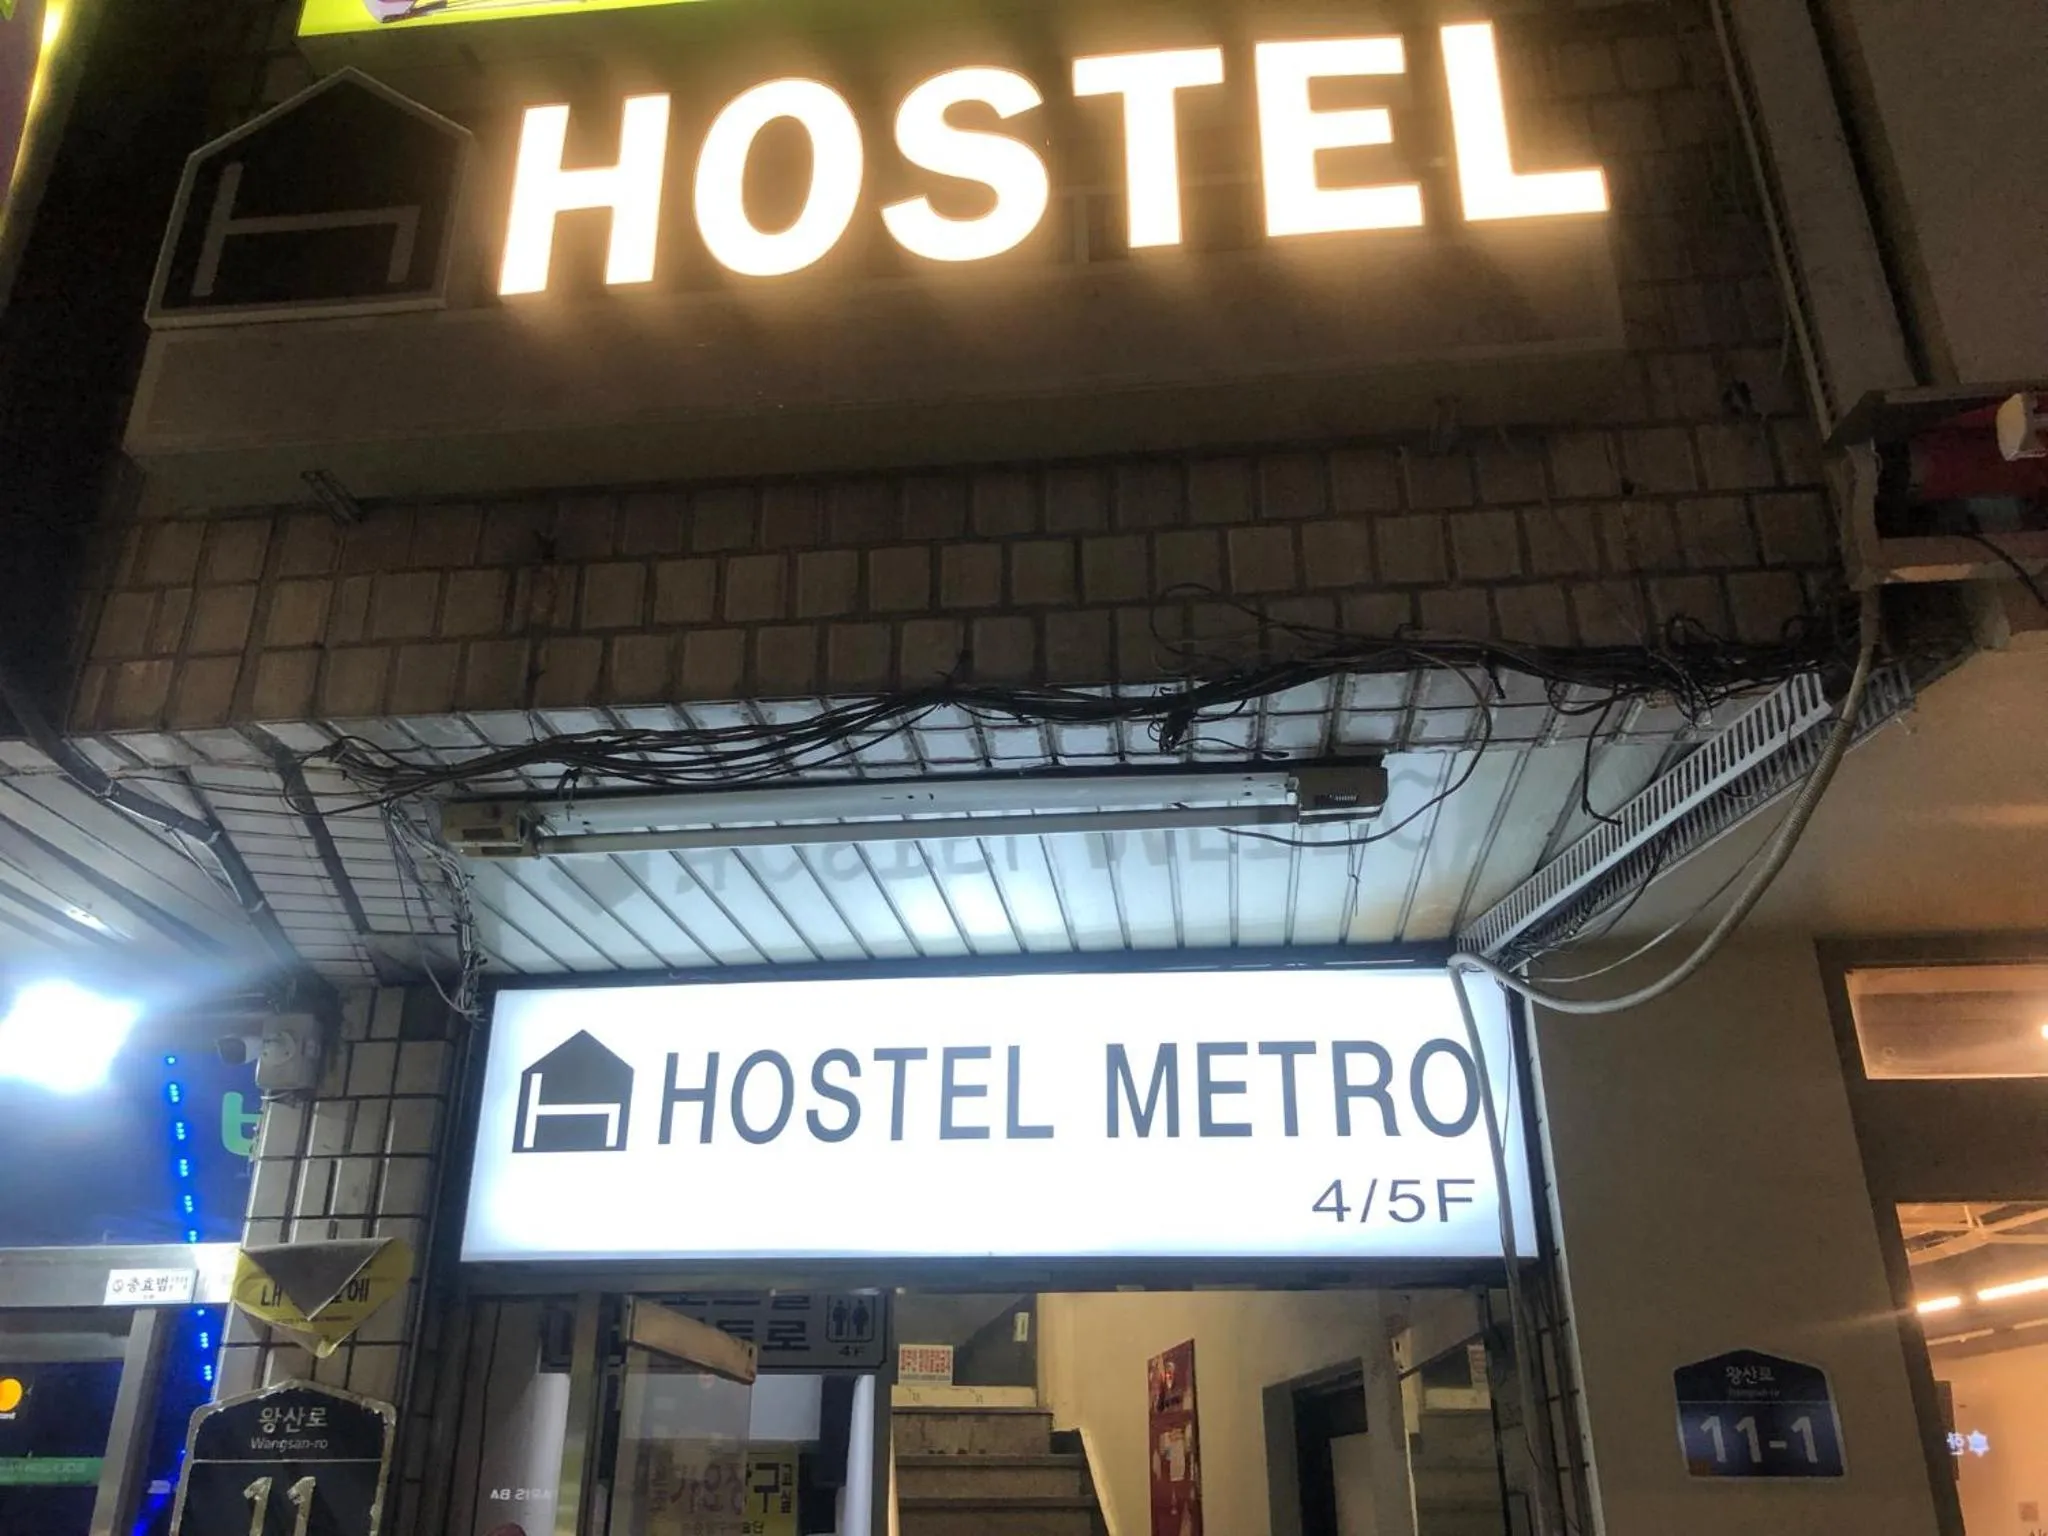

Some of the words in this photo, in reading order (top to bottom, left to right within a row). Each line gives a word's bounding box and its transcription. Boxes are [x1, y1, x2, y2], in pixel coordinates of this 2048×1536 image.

[498, 20, 1610, 297] HOSTEL
[657, 1045, 1055, 1145] HOSTEL
[1106, 1038, 1482, 1138] METRO
[1311, 1178, 1476, 1223] 4/5F
[838, 1345, 863, 1357] 4F
[1725, 1366, 1776, 1385] 왕산로
[257, 1406, 328, 1433] 왕산로
[1700, 1415, 1819, 1464] 11-1
[250, 1436, 329, 1453] Wangsan-ro
[243, 1475, 318, 1536] 11
